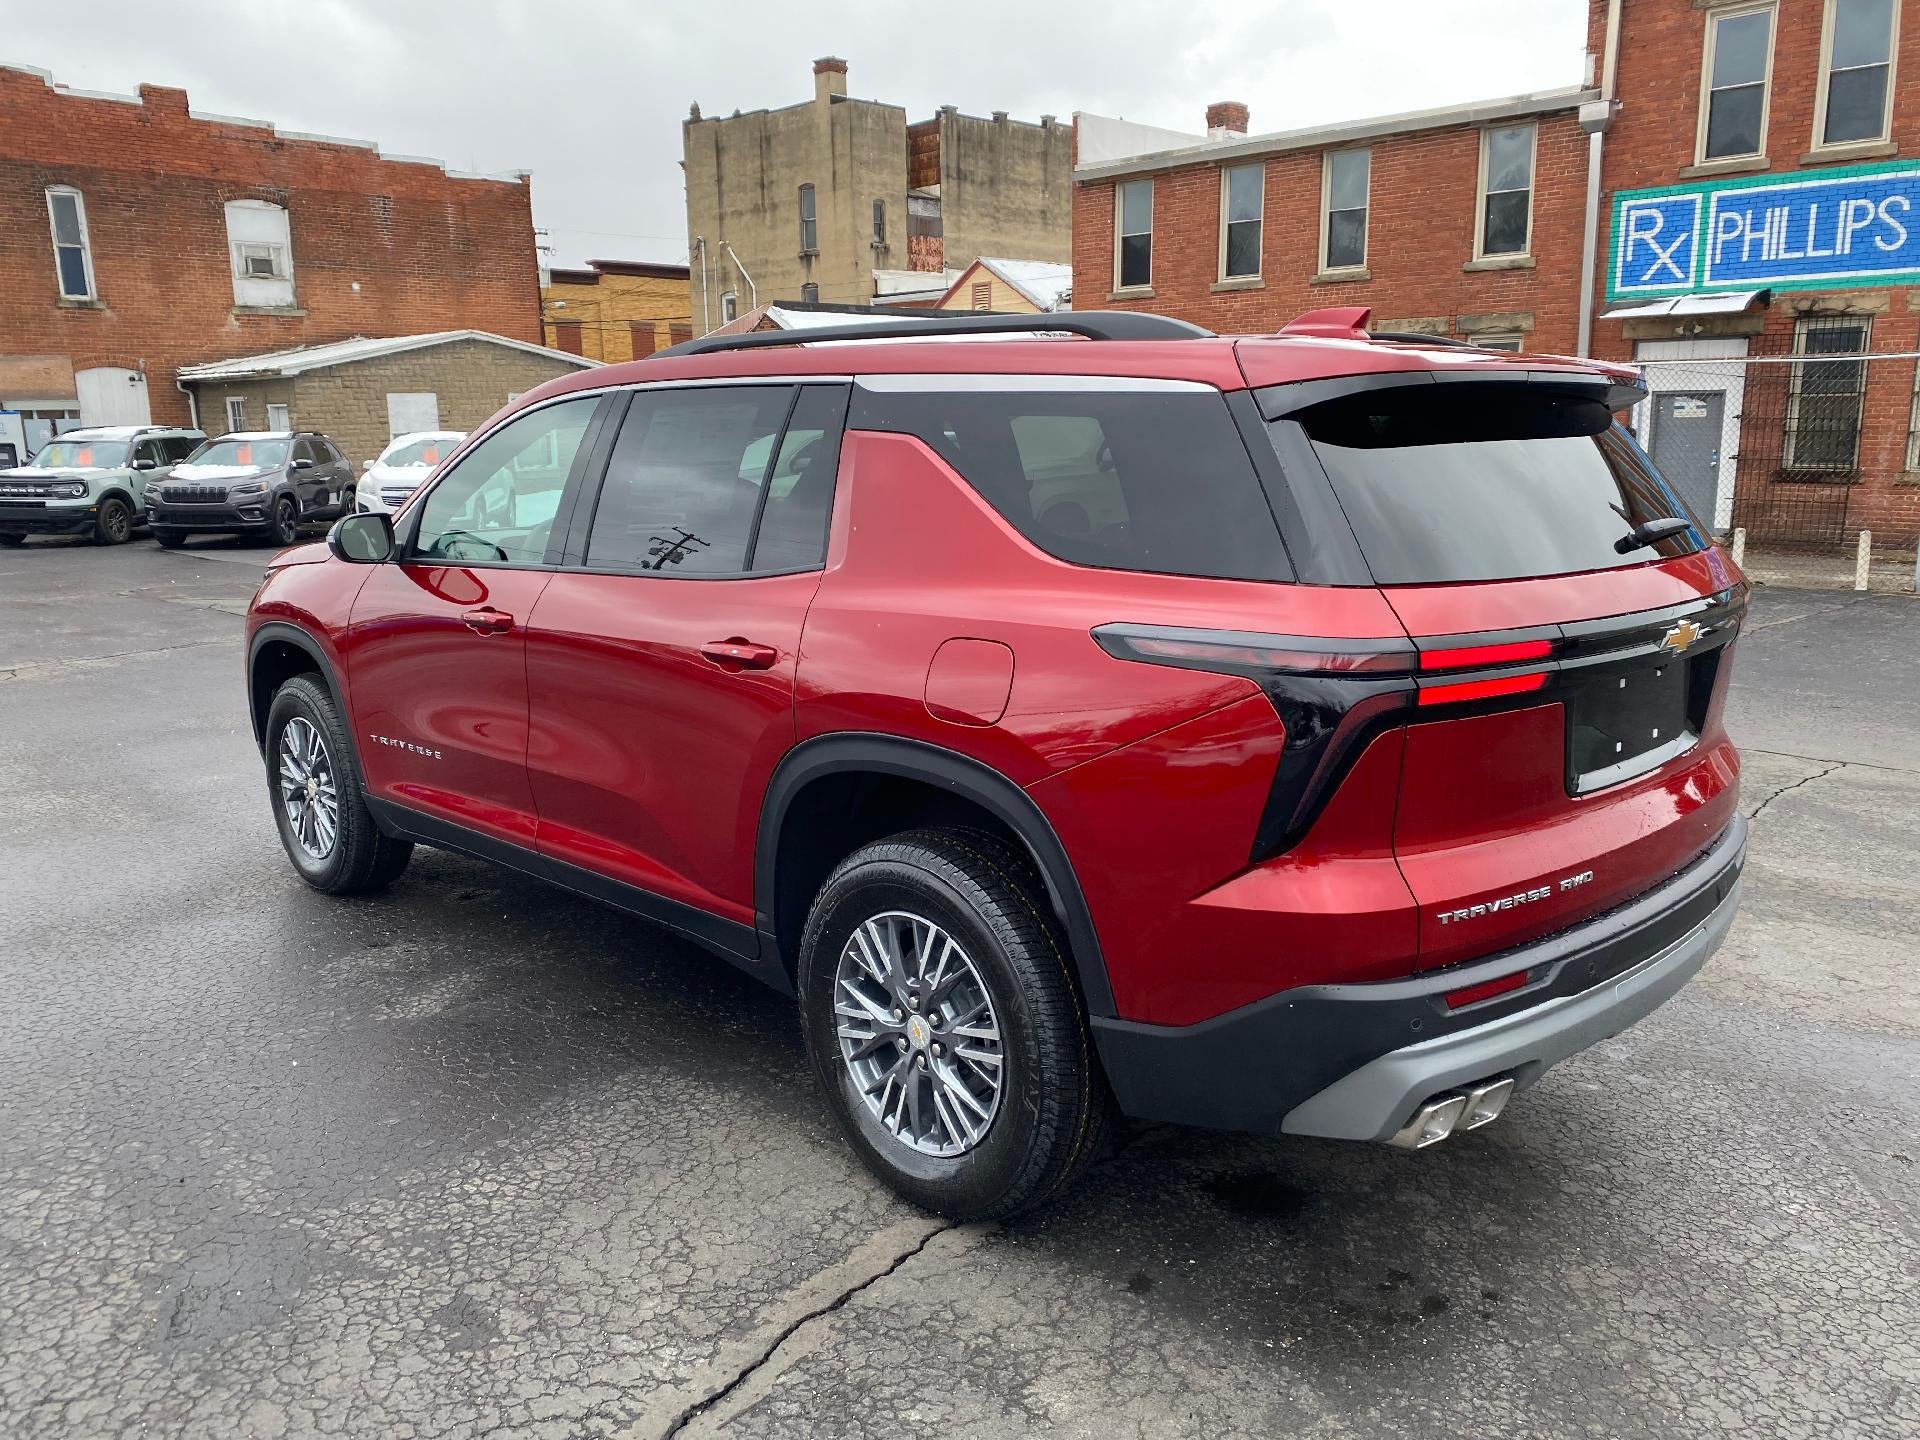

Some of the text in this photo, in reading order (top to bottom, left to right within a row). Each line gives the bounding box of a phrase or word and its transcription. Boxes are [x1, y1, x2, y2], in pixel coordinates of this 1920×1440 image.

[1714, 194, 1911, 265] PHILLIPS
[369, 733, 442, 760] TRAVERSE
[1436, 870, 1594, 925] TRAVERSE AWD
